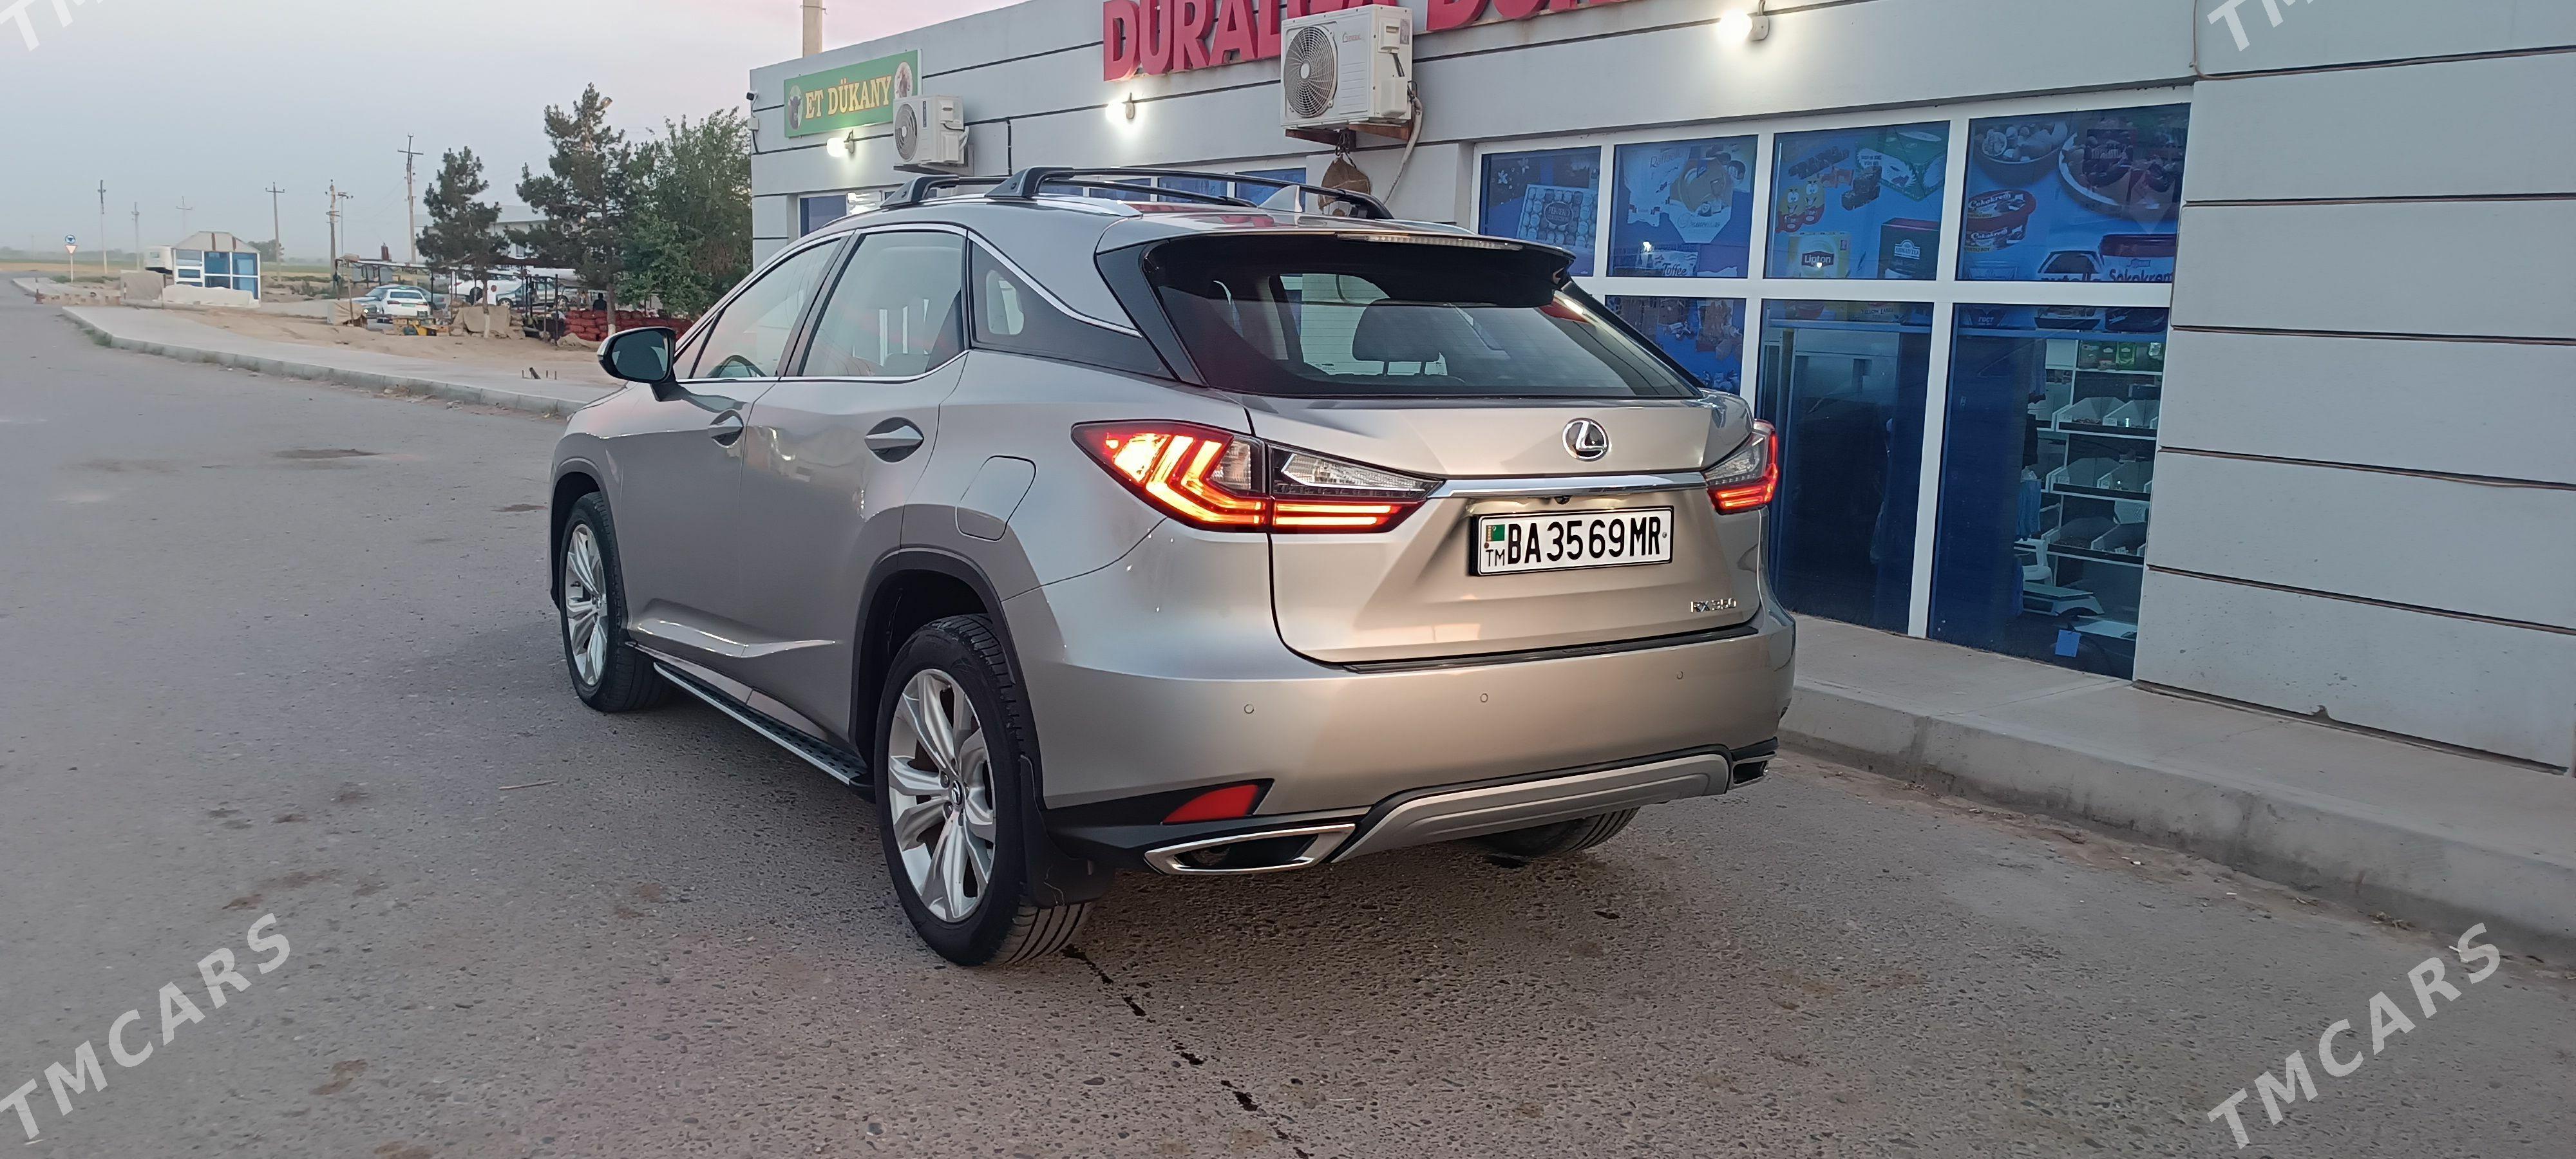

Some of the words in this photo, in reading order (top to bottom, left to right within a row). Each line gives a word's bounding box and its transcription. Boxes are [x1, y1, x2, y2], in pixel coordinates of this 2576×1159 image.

[1103, 0, 1397, 82] DURAL
[805, 89, 824, 120] ET
[828, 75, 893, 117] DÜKANY
[1662, 263, 1687, 276] Toffee
[1804, 254, 1832, 267] Lipton
[1486, 549, 1505, 567] TM
